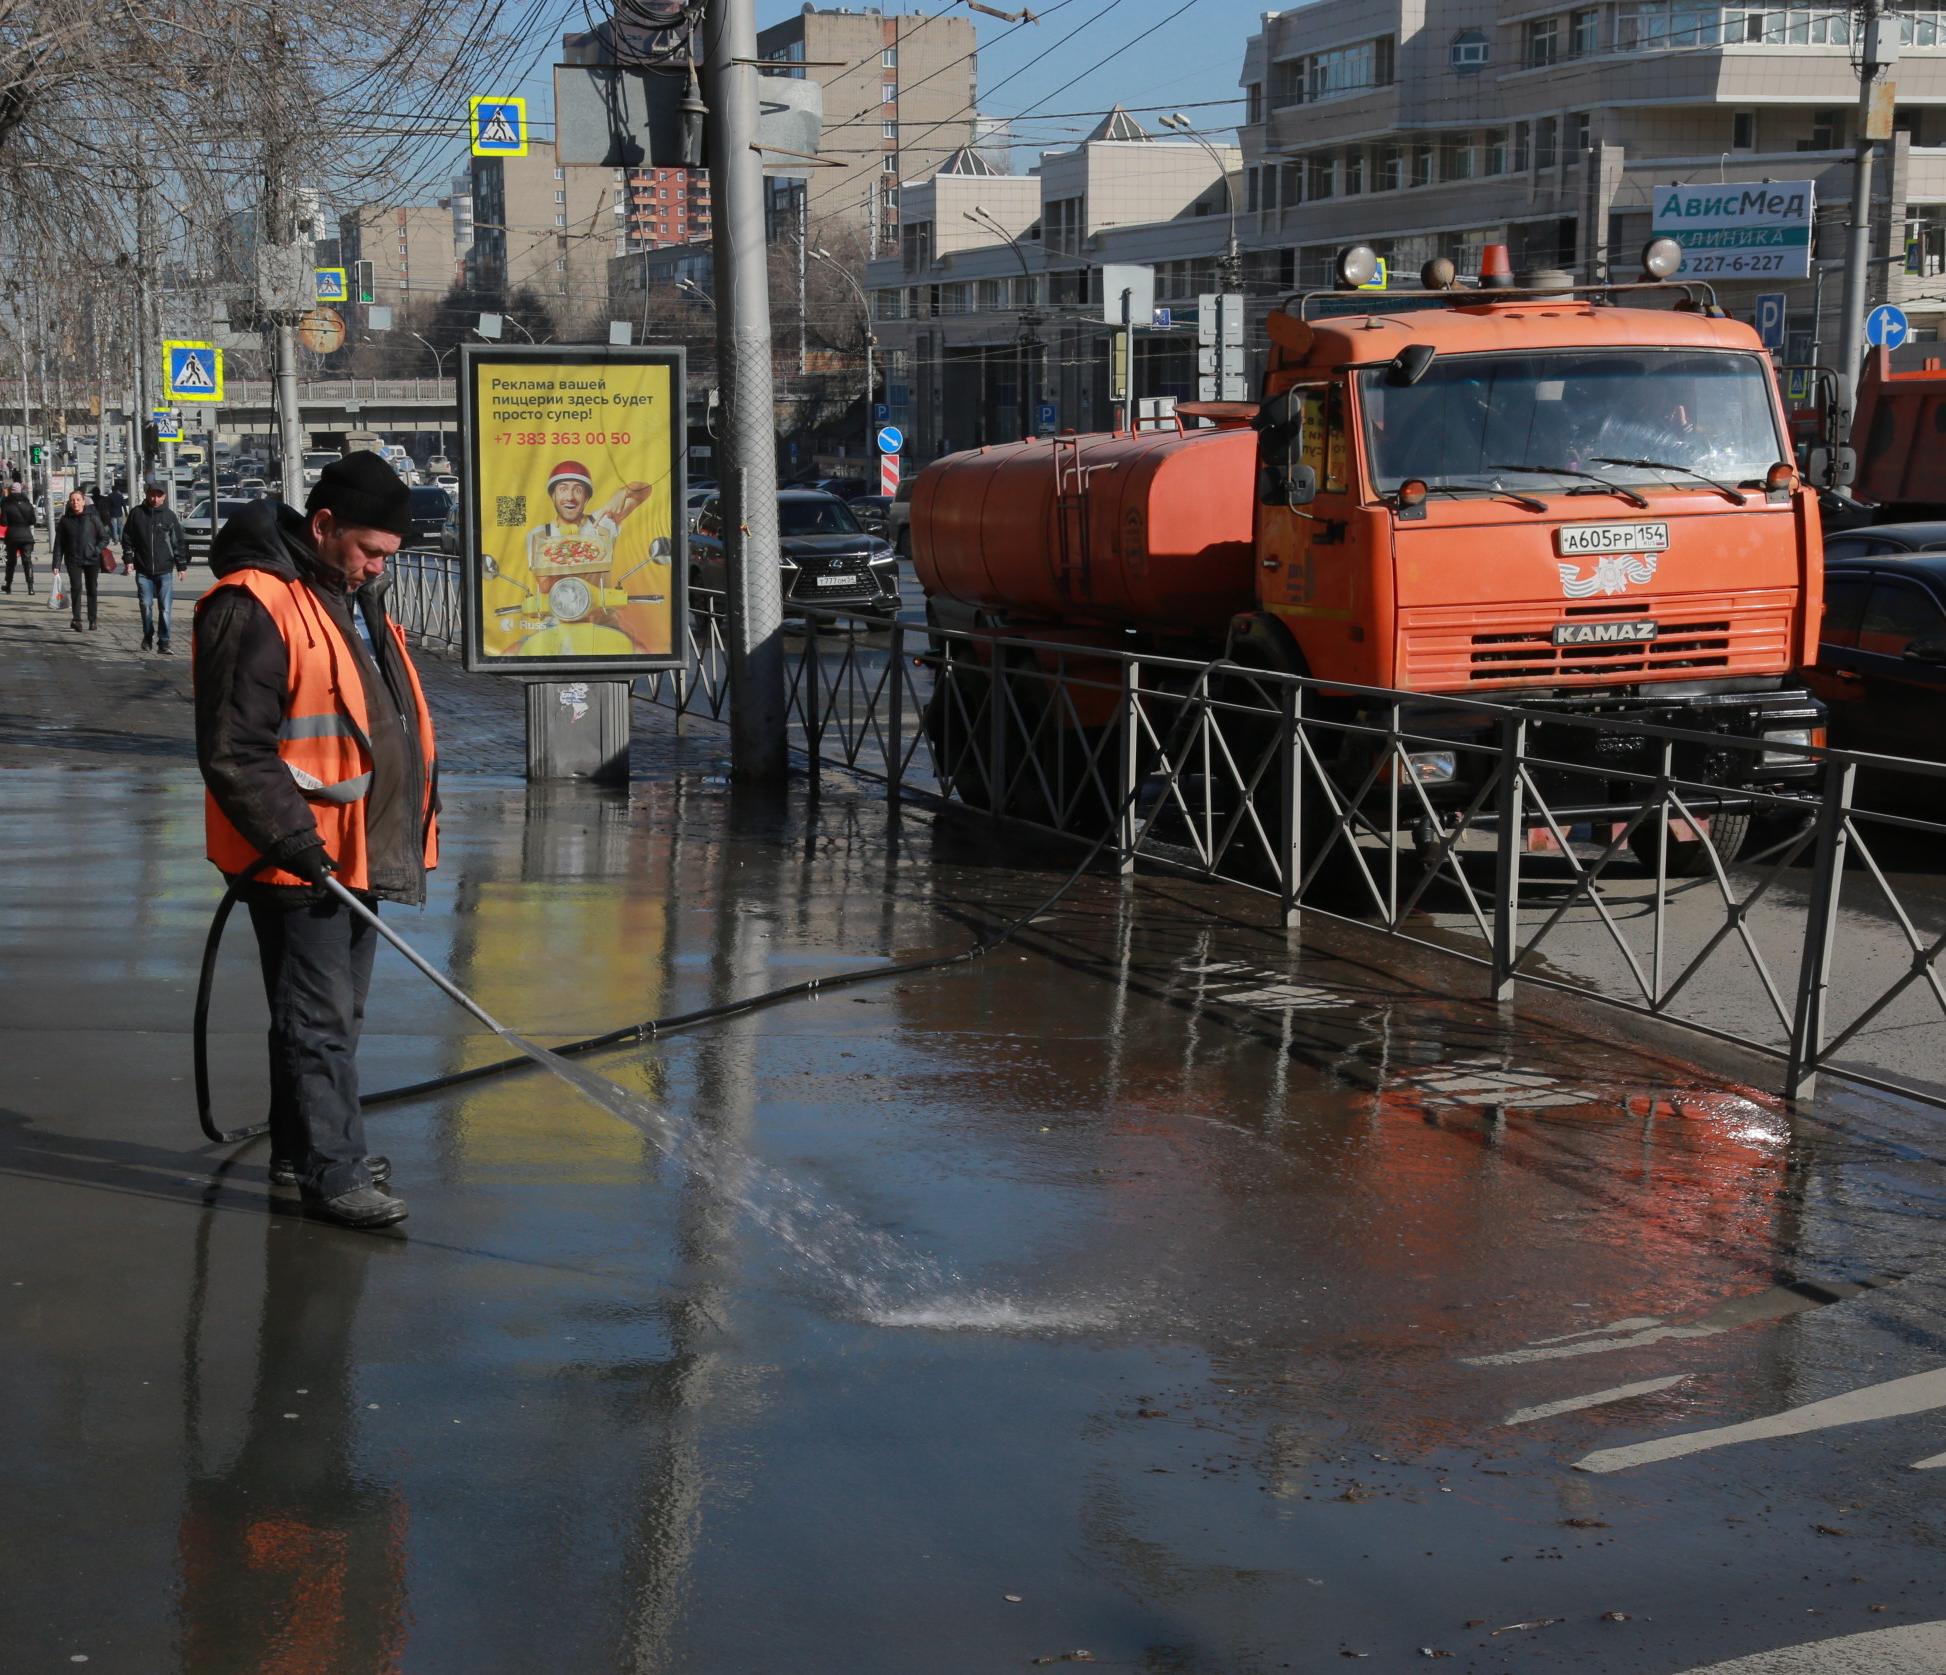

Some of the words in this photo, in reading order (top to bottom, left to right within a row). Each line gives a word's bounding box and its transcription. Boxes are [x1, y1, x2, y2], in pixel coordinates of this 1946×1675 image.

[1659, 190, 1804, 218] АвисМед
[1675, 230, 1784, 248] КЛИНИКА
[1693, 255, 1784, 273] 227-6-227
[1763, 301, 1777, 345] P
[491, 378, 555, 390] Реклама
[559, 378, 606, 390] вашей
[492, 395, 564, 407] пиццерии
[568, 395, 609, 407] здесь
[613, 394, 653, 407] будет
[493, 410, 543, 422] просто
[547, 409, 592, 422] супер!
[1042, 407, 1052, 421] P
[494, 432, 512, 445] +7
[517, 432, 546, 445] 383
[551, 432, 581, 445] 363
[586, 432, 606, 445] 00
[611, 432, 631, 444] 50
[1637, 526, 1664, 541] 154
[1557, 623, 1655, 643] KAMAZ
